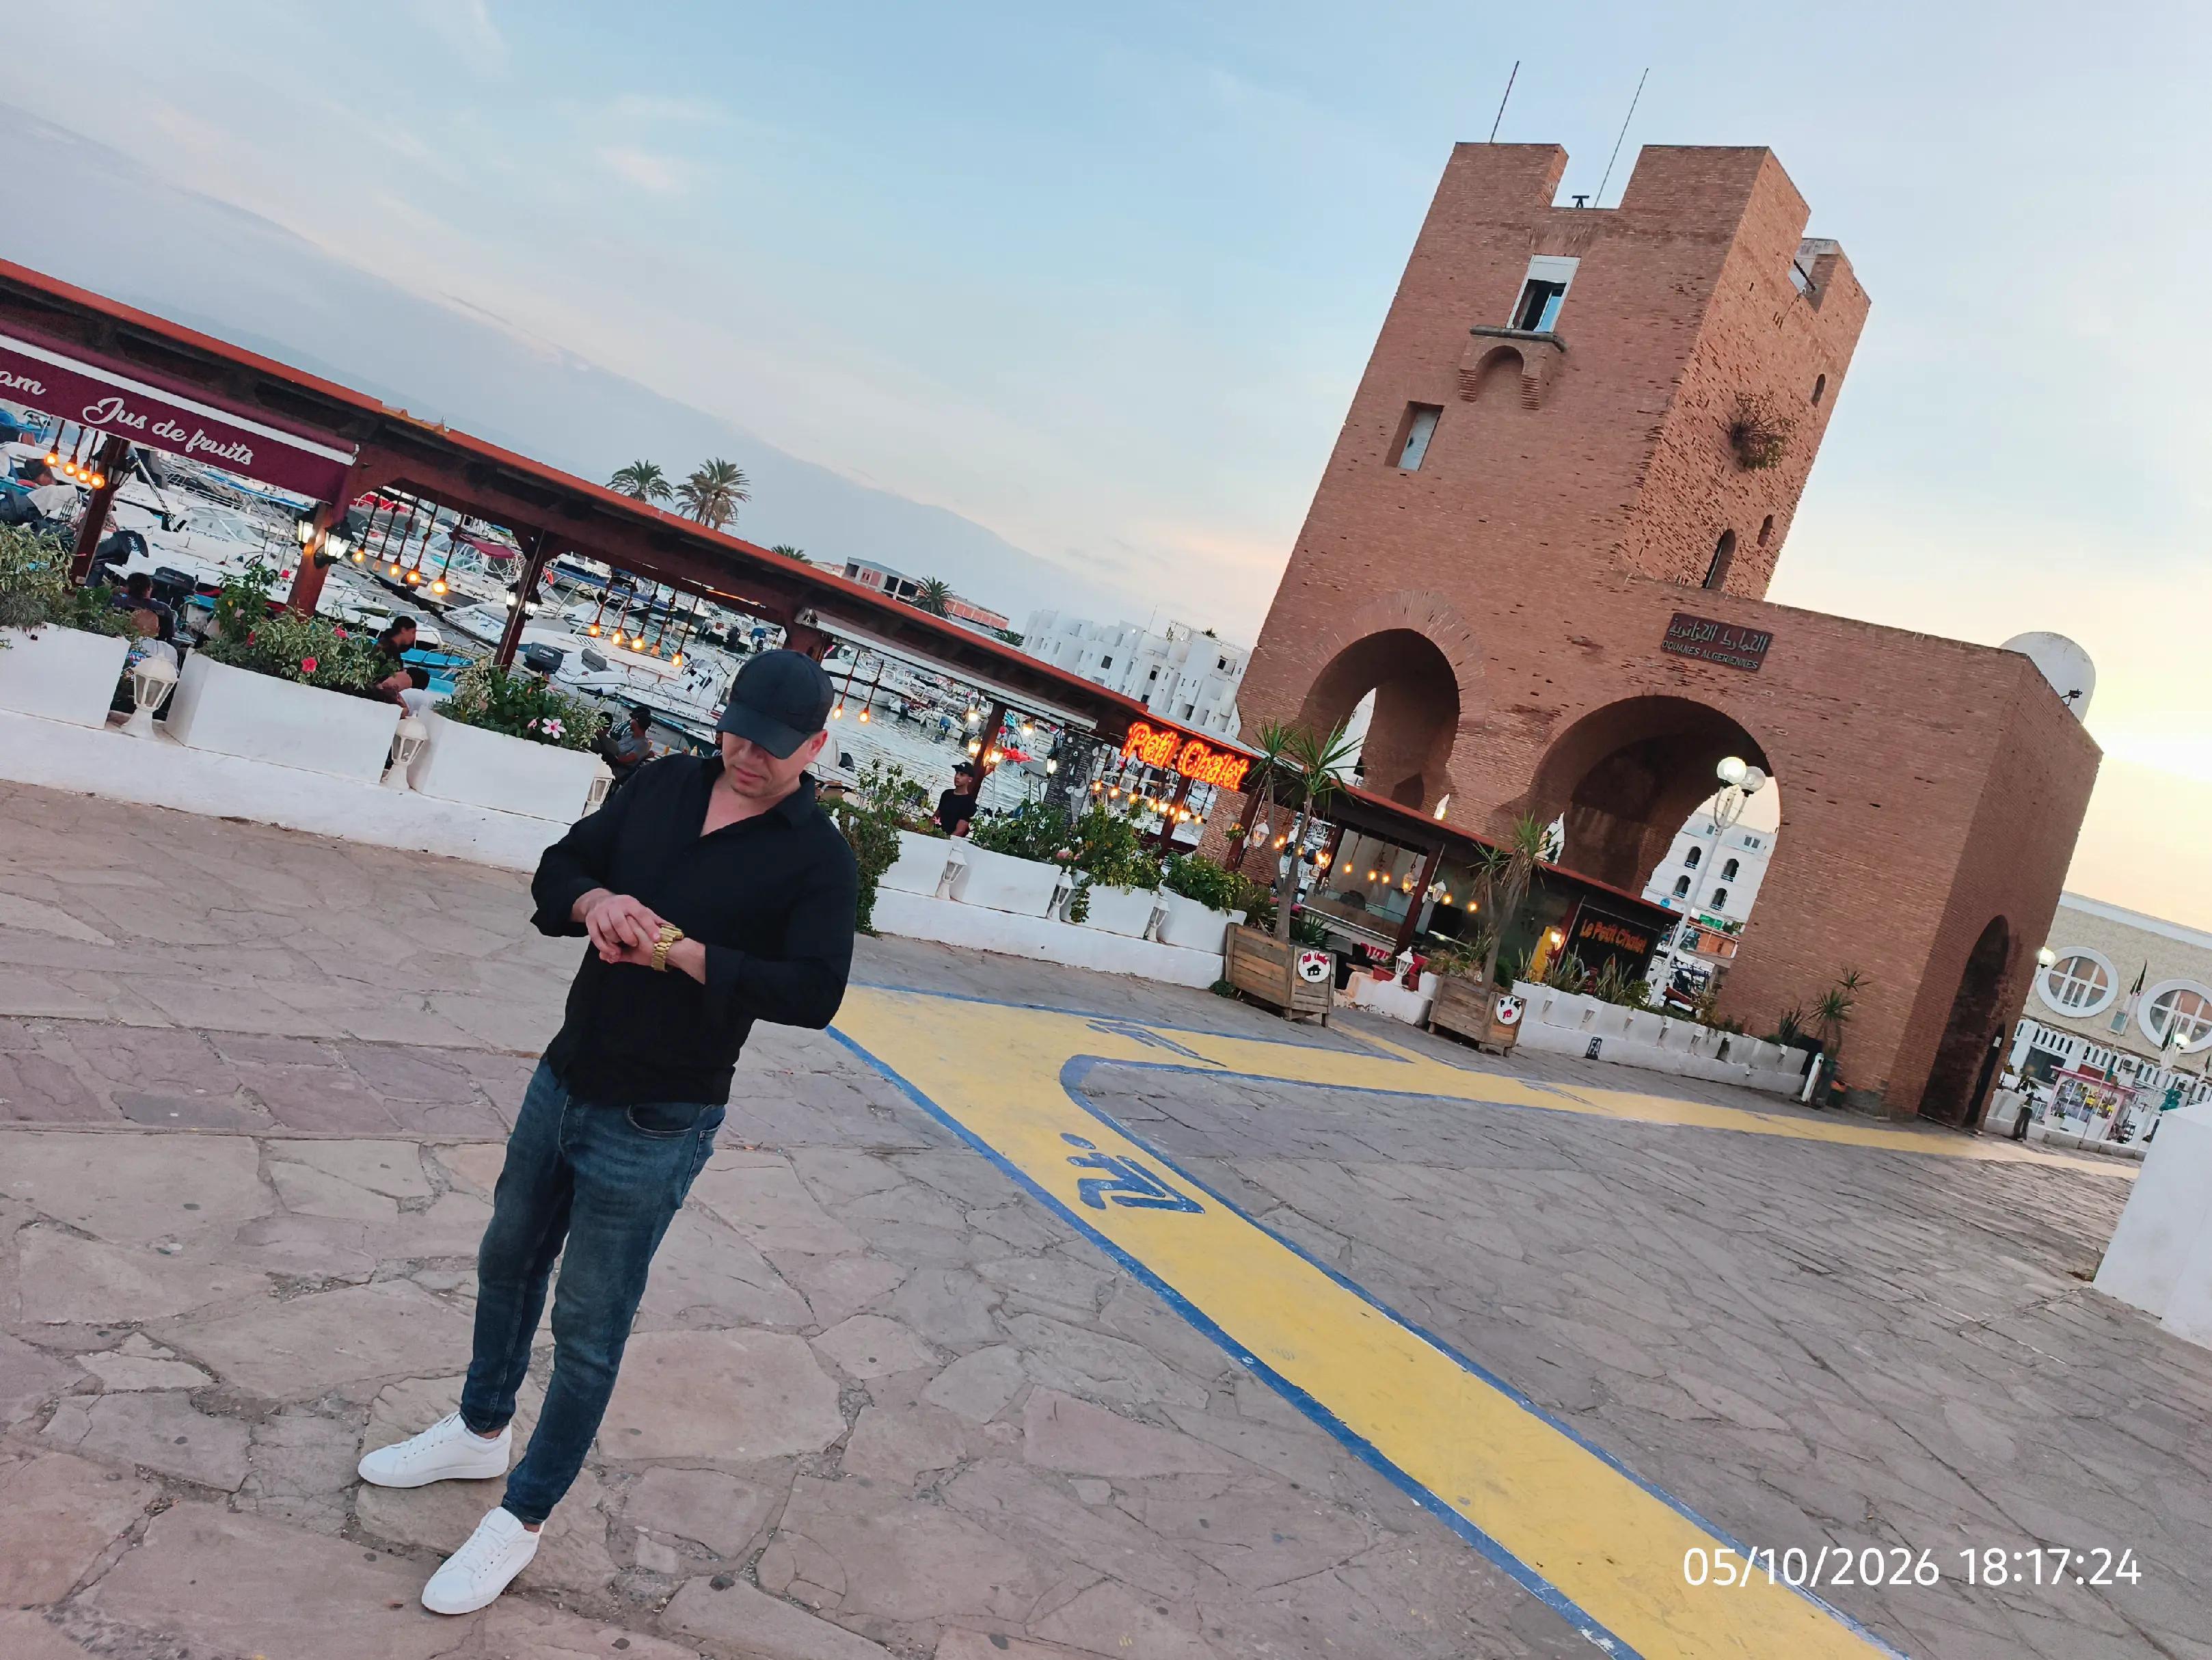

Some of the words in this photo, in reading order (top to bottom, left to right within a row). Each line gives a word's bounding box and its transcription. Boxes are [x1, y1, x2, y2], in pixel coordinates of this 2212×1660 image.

[82, 397, 148, 430] Jus
[152, 419, 187, 442] de
[185, 429, 255, 466] fruits
[1662, 640, 1701, 656] DOUANES
[1701, 650, 1759, 669] ALGERIENNES
[1177, 739, 1250, 791] Chalet
